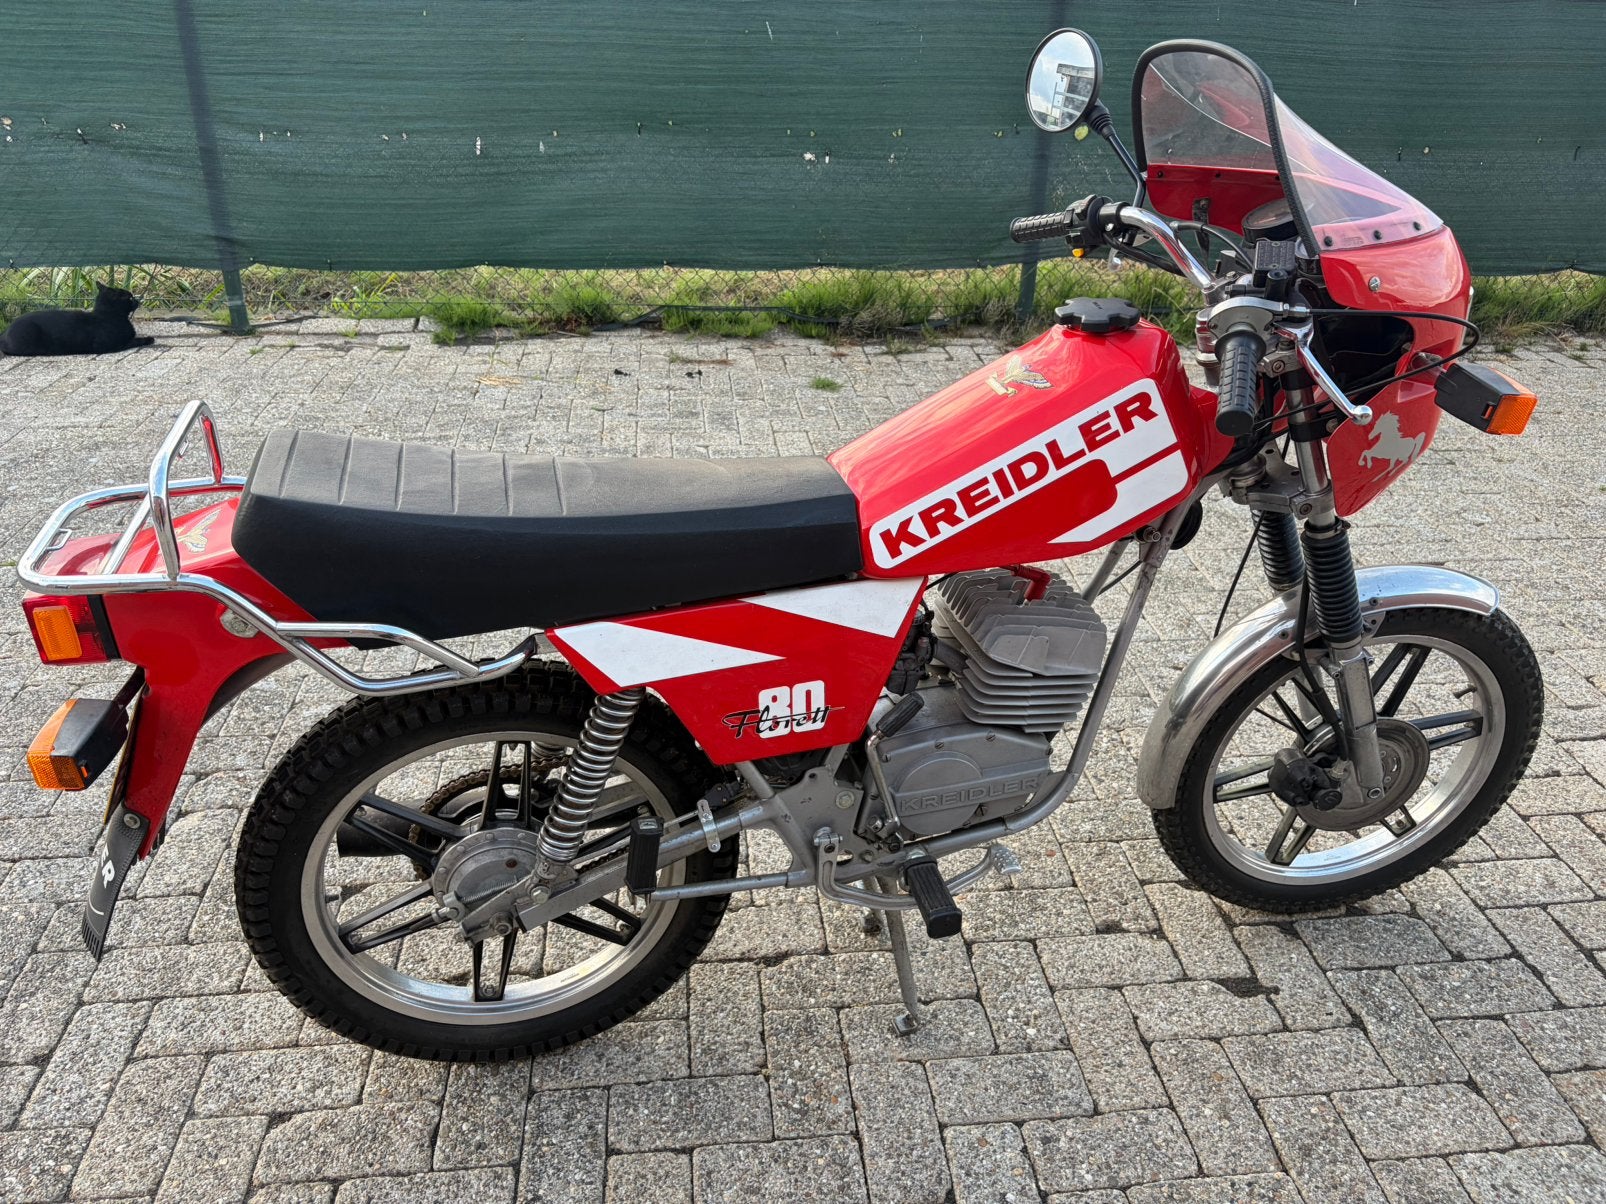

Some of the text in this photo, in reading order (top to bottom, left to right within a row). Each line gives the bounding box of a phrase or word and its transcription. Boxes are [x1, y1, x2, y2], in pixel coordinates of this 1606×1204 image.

[879, 391, 1158, 560] KREIDLER
[722, 704, 845, 739] Florett
[758, 680, 825, 739] 80
[903, 777, 1039, 811] KREIDLER
